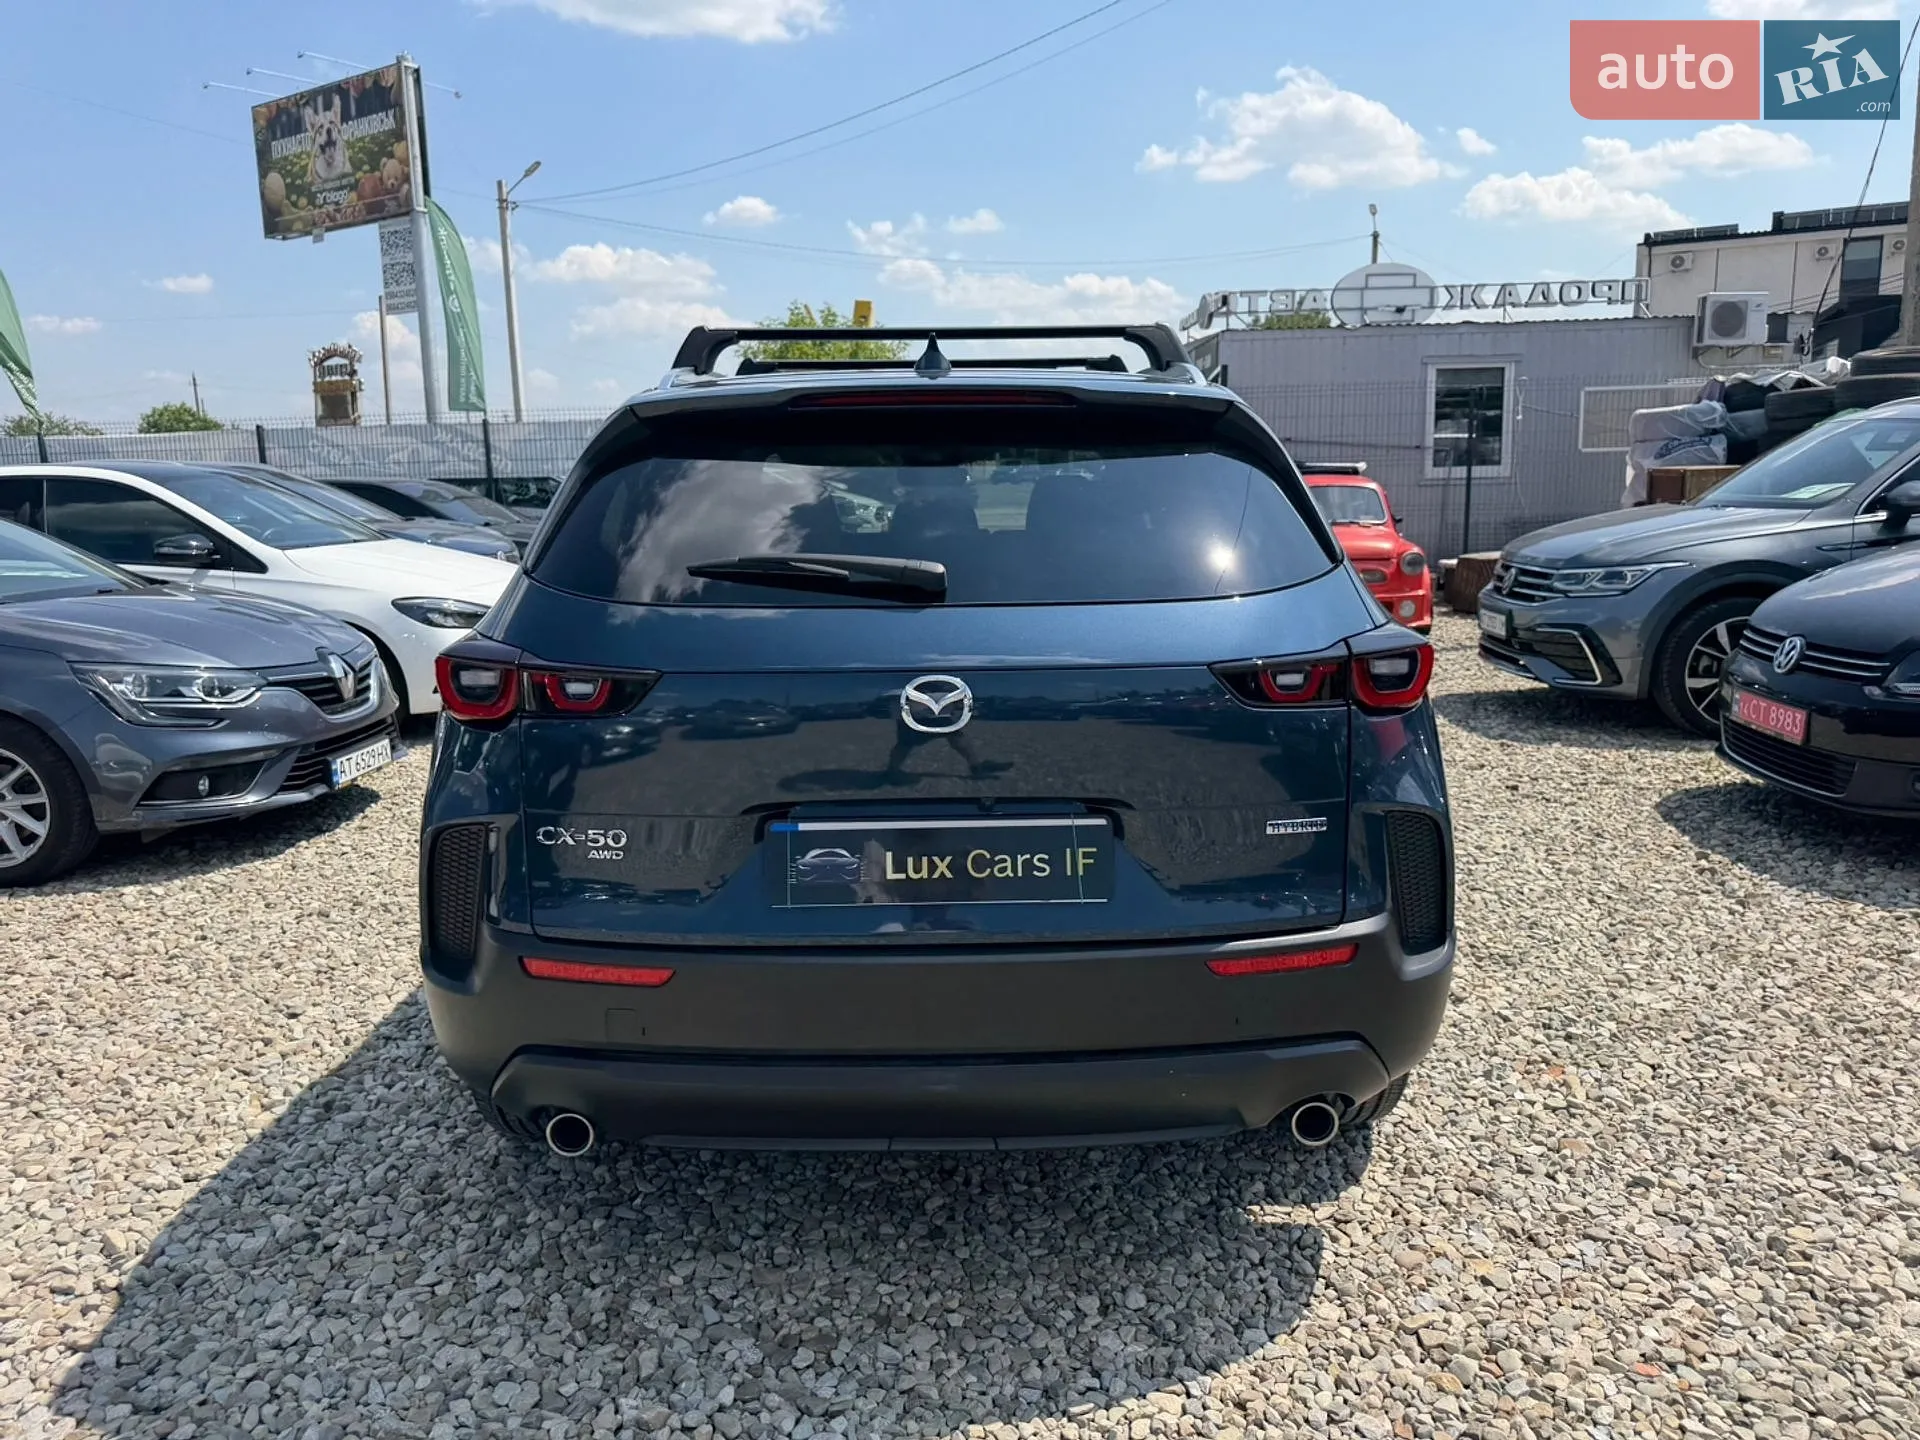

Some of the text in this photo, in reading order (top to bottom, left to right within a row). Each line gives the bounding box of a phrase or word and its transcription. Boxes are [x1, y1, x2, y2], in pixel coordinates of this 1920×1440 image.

[341, 108, 396, 141] ФРАНКІВСЬК
[1769, 706, 1802, 734] 8983
[340, 757, 352, 780] AT
[355, 748, 376, 772] 6529
[536, 826, 627, 848] CX-50
[587, 849, 624, 860] AWD
[885, 847, 1098, 879] Lux Cars IF
